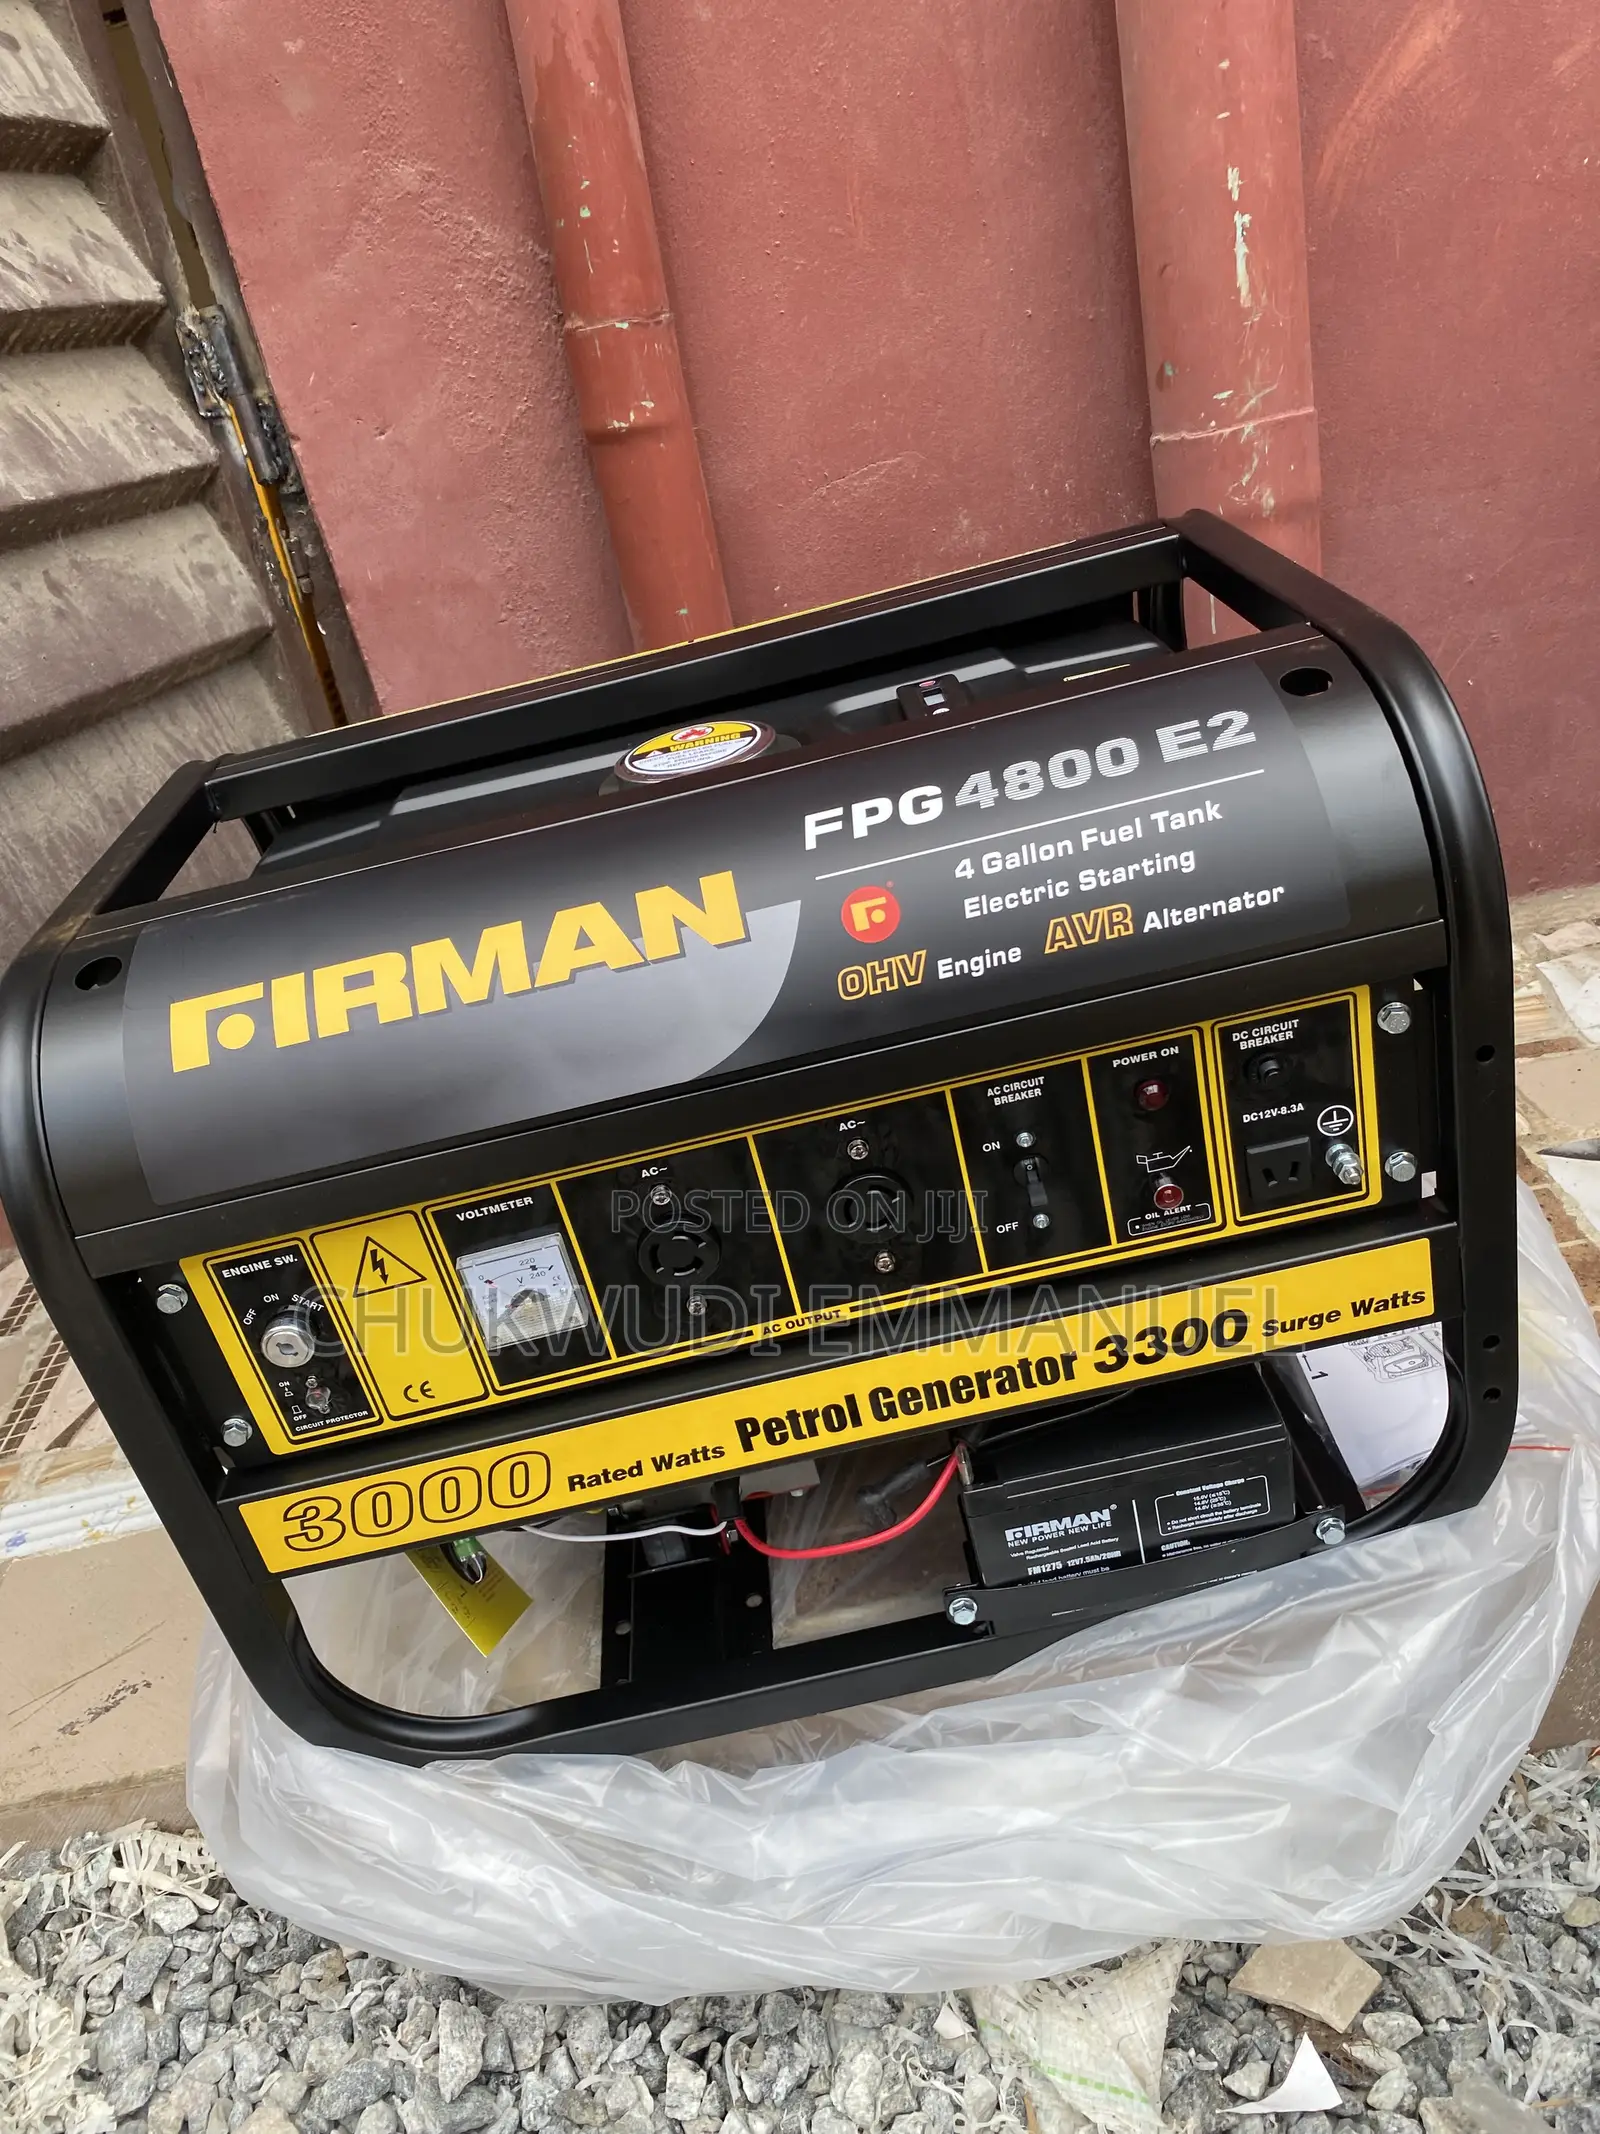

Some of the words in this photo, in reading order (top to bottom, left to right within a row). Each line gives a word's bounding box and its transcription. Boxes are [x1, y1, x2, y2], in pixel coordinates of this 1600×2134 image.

[669, 732, 741, 753] WARNING
[1155, 709, 1257, 763] E2
[954, 859, 975, 881] 4
[981, 836, 1074, 877] Gallon
[1081, 819, 1143, 852] Fuel
[1156, 800, 1223, 834] Tank
[963, 874, 1069, 919] Electric
[1079, 850, 1196, 891] Starting
[837, 949, 927, 1001] OHV
[937, 945, 1022, 980] Engine
[1044, 903, 1134, 954] AVR
[1142, 885, 1285, 934] Alternator
[169, 870, 747, 1073] FIRMAN
[1232, 1031, 1251, 1042] DC
[1253, 1019, 1299, 1038] CIRCUIT
[1239, 1030, 1294, 1050] BREAKER
[1112, 1051, 1157, 1068] POWER
[1160, 1046, 1180, 1058] ON
[986, 1086, 1002, 1097] AC
[1003, 1076, 1045, 1094] CIRCUIT
[993, 1088, 1043, 1106] BREAKER
[1242, 1102, 1305, 1124] DC12V-8.3A
[982, 1140, 1001, 1153] ON
[456, 1196, 534, 1222] VOLTMETER
[1144, 1211, 1161, 1220] OIL
[1163, 1204, 1192, 1217] ALERT
[995, 1220, 1020, 1234] OFF
[221, 1258, 272, 1279] ENGINE
[273, 1253, 299, 1269] SW.
[518, 1257, 536, 1266] 220
[529, 1270, 547, 1280] 240
[262, 1292, 280, 1304] ON
[290, 1293, 326, 1314] START
[242, 1307, 258, 1327] OFF
[762, 1322, 782, 1336] AC
[785, 1309, 841, 1331] OUTPUT
[278, 1380, 291, 1388] ON
[282, 1450, 552, 1552] 3000
[567, 1459, 644, 1493] Rated
[650, 1444, 726, 1473] Watts
[734, 1393, 862, 1453] Petrol
[868, 1350, 1078, 1422] Generator
[1093, 1308, 1248, 1374] 3300
[1261, 1308, 1342, 1337] Surge
[1350, 1286, 1427, 1318] Watts
[293, 1413, 308, 1422] OFF
[295, 1420, 325, 1432] CIRCUIT
[325, 1410, 369, 1427] PROTECTOR
[1004, 1508, 1111, 1542] FIRMAN
[1007, 1539, 1029, 1548] NEW
[1032, 1530, 1065, 1543] POWER
[1068, 1525, 1089, 1535] NEW
[1092, 1520, 1113, 1530] LIFE
[1027, 1560, 1063, 1576] FM1275
